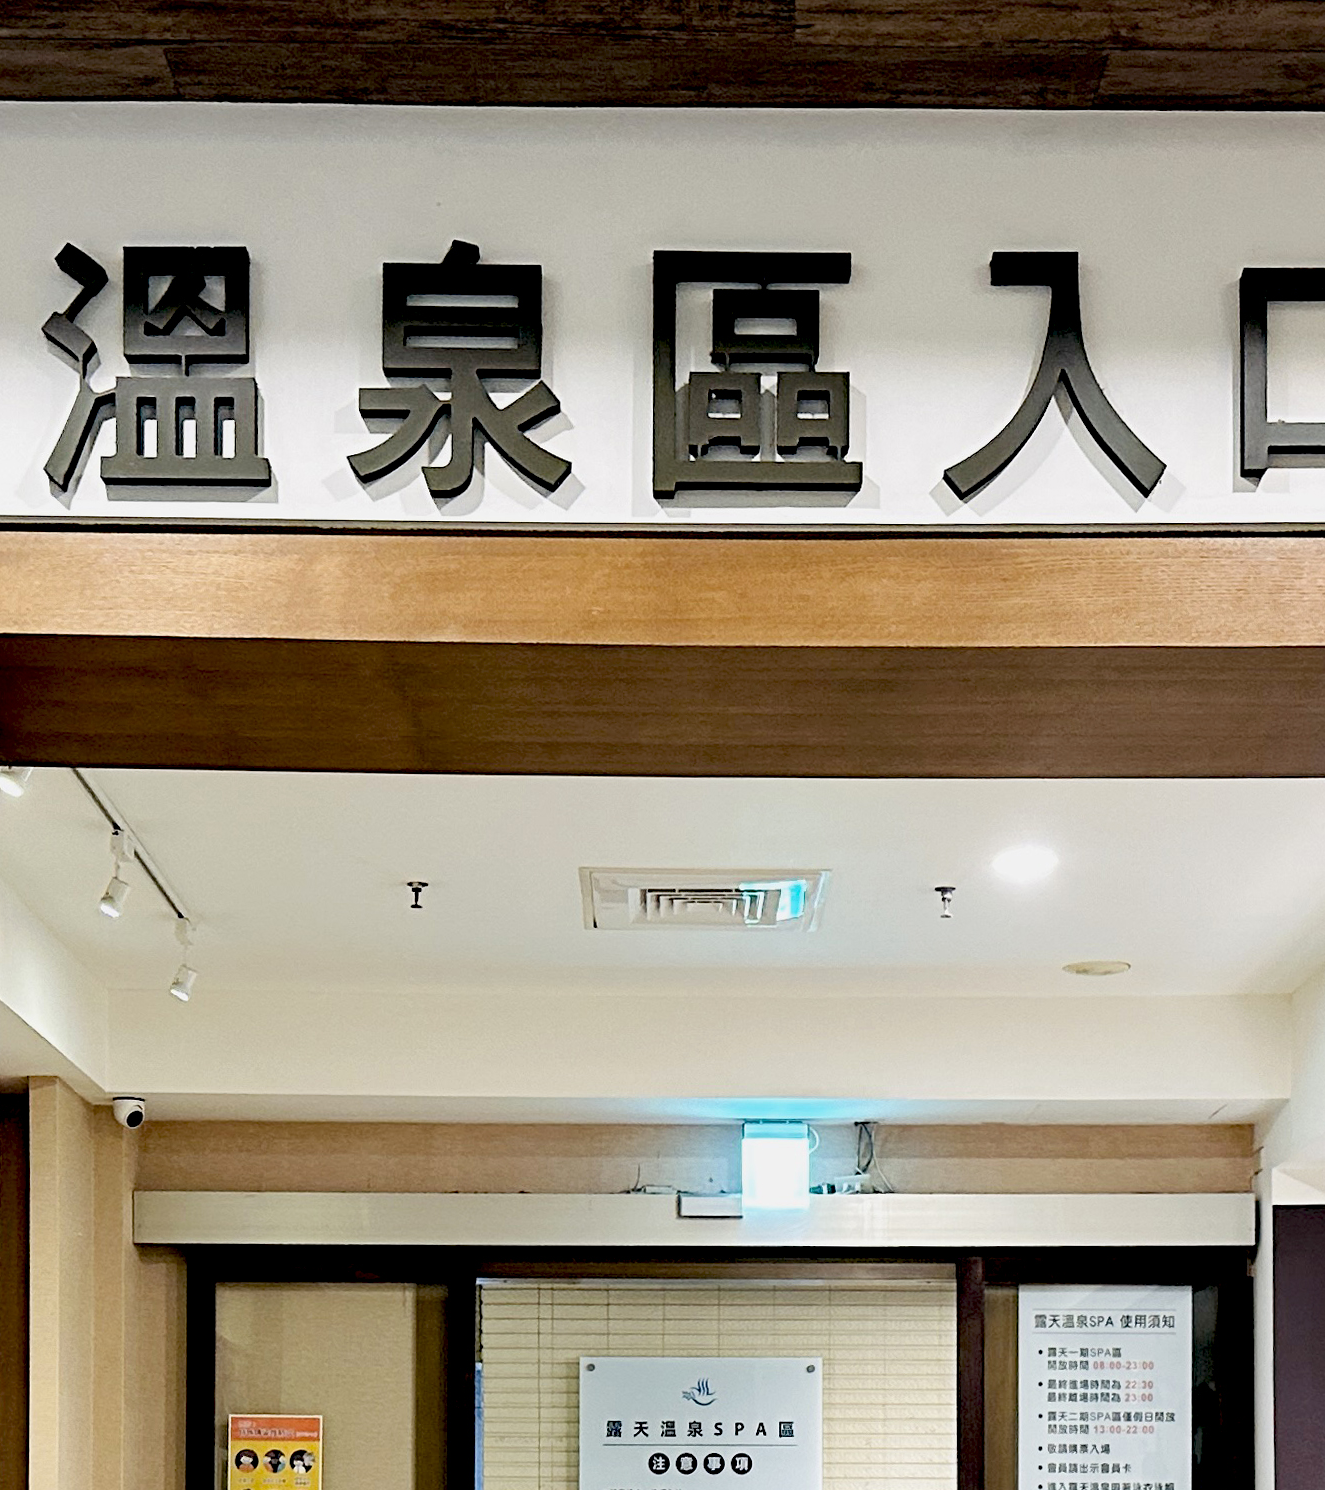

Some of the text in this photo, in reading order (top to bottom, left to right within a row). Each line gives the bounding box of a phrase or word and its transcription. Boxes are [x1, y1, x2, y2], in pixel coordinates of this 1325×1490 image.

[1119, 1314, 1175, 1329] 使用須知
[1124, 1380, 1154, 1390] 22:30
[1124, 1392, 1154, 1403] 23:00
[650, 1454, 750, 1473] 注意事項
